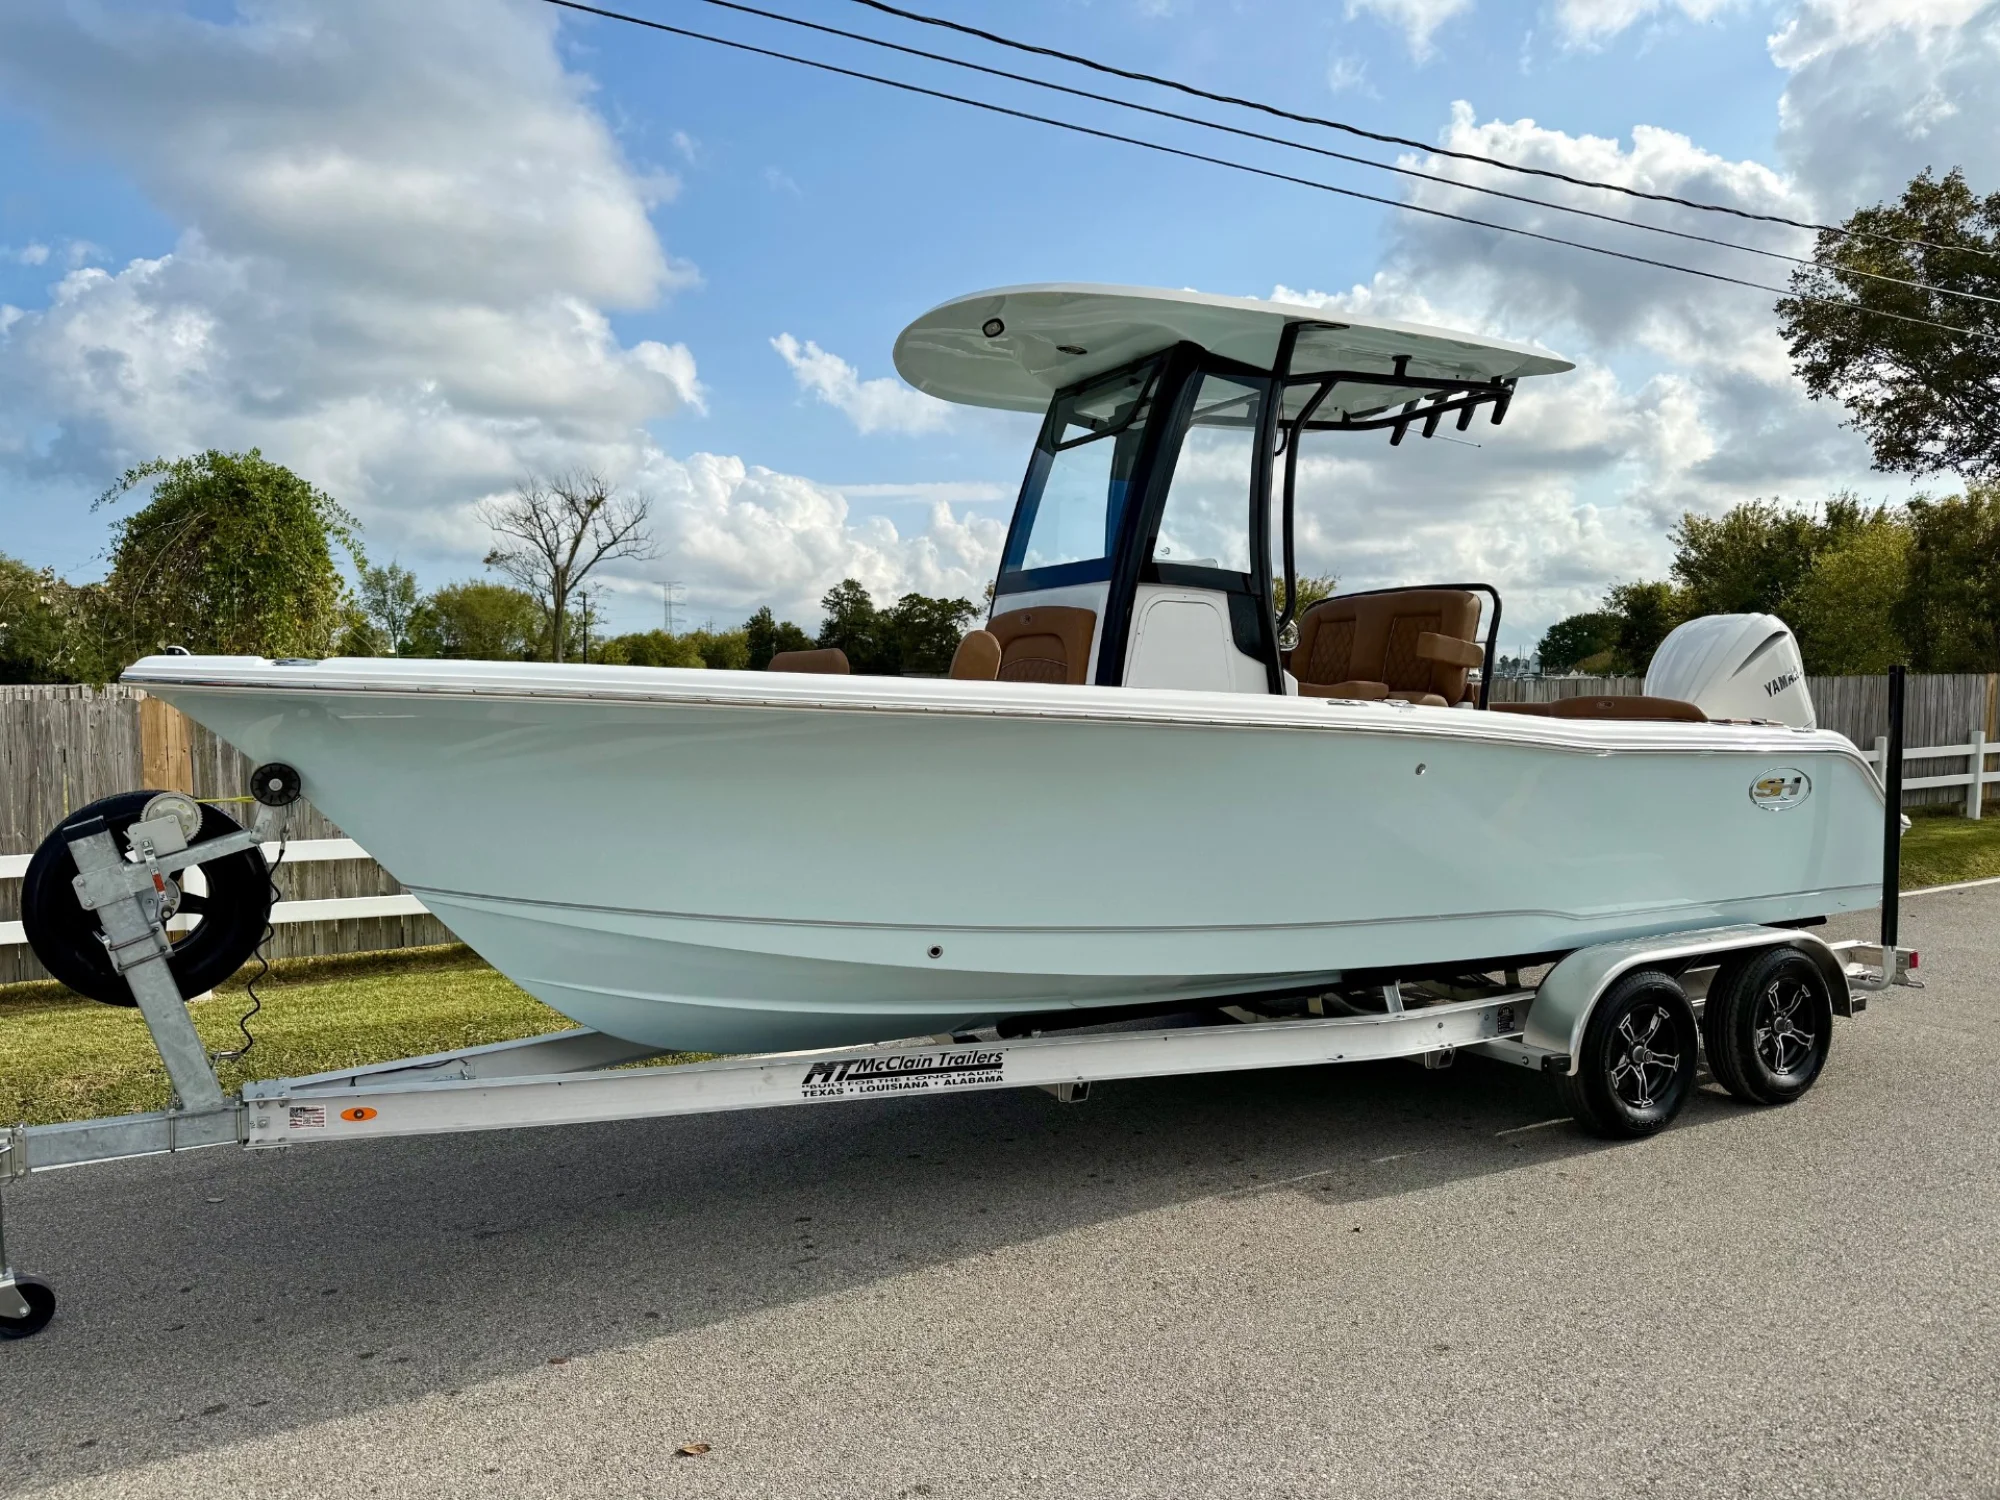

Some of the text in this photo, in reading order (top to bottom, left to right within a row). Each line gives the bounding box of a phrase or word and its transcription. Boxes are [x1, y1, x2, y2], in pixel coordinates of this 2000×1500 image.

[1764, 667, 1802, 698] YAMA
[855, 1050, 1004, 1073] McClain Trailers
[802, 1075, 1004, 1098] TEXAS LOUISIANA ALABAMA
[848, 1079, 874, 1087] FOR
[906, 1073, 952, 1082] LONG
